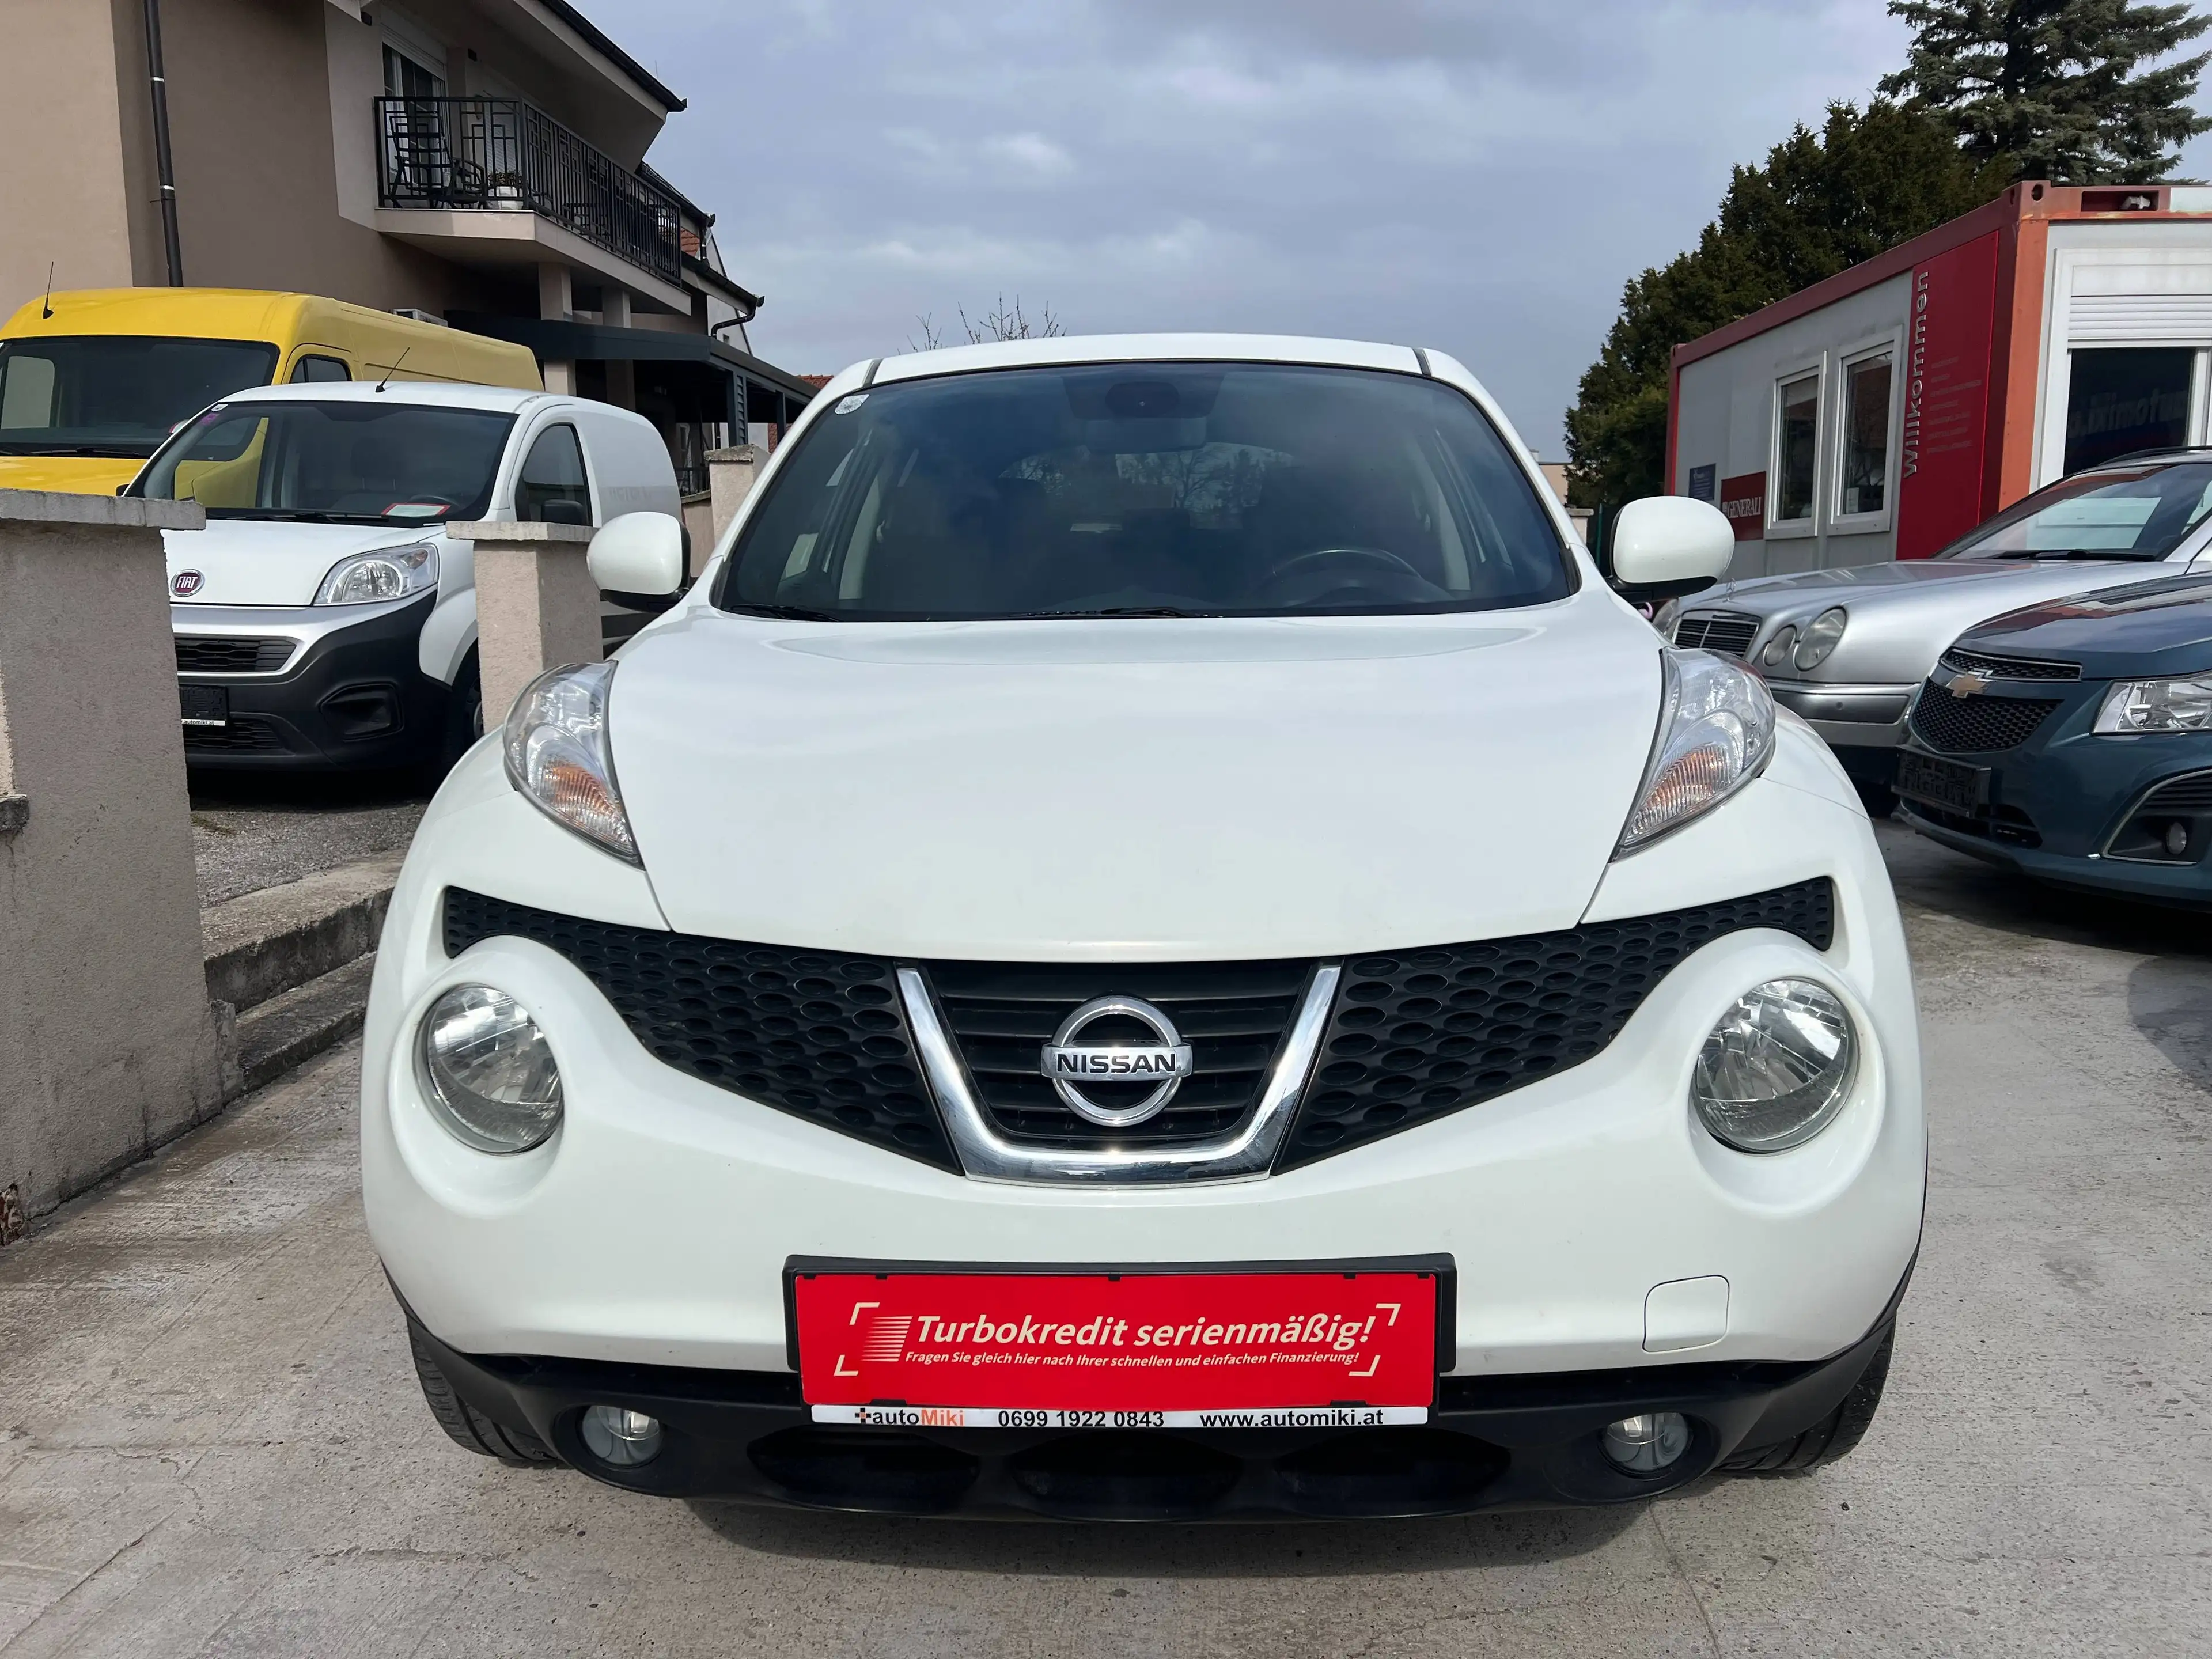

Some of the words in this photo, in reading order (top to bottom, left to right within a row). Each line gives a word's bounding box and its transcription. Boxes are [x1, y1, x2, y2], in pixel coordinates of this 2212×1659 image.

[1729, 497, 1761, 518] GENERALI
[176, 576, 198, 588] FIAT
[1056, 1054, 1176, 1073] NISSAN
[918, 1314, 1128, 1346] Turbokredit
[1132, 1313, 1376, 1351] serienmäßig!
[905, 1351, 949, 1365] Fragen
[951, 1351, 971, 1363] Sie
[972, 1351, 1012, 1366] gleich
[1014, 1353, 1041, 1365] hier
[1043, 1354, 1074, 1366] nach
[1076, 1354, 1110, 1366] Ihrer
[1110, 1354, 1172, 1367] schnellen
[1175, 1354, 1202, 1366] und
[1203, 1353, 1267, 1366] einfachen
[1269, 1351, 1360, 1366] Finanzierung!
[872, 1409, 964, 1426] autoMiki
[998, 1410, 1048, 1427] 0699
[1056, 1410, 1107, 1427] 1922
[1113, 1410, 1165, 1427] 0843
[1200, 1409, 1384, 1427] www.automiki.at
